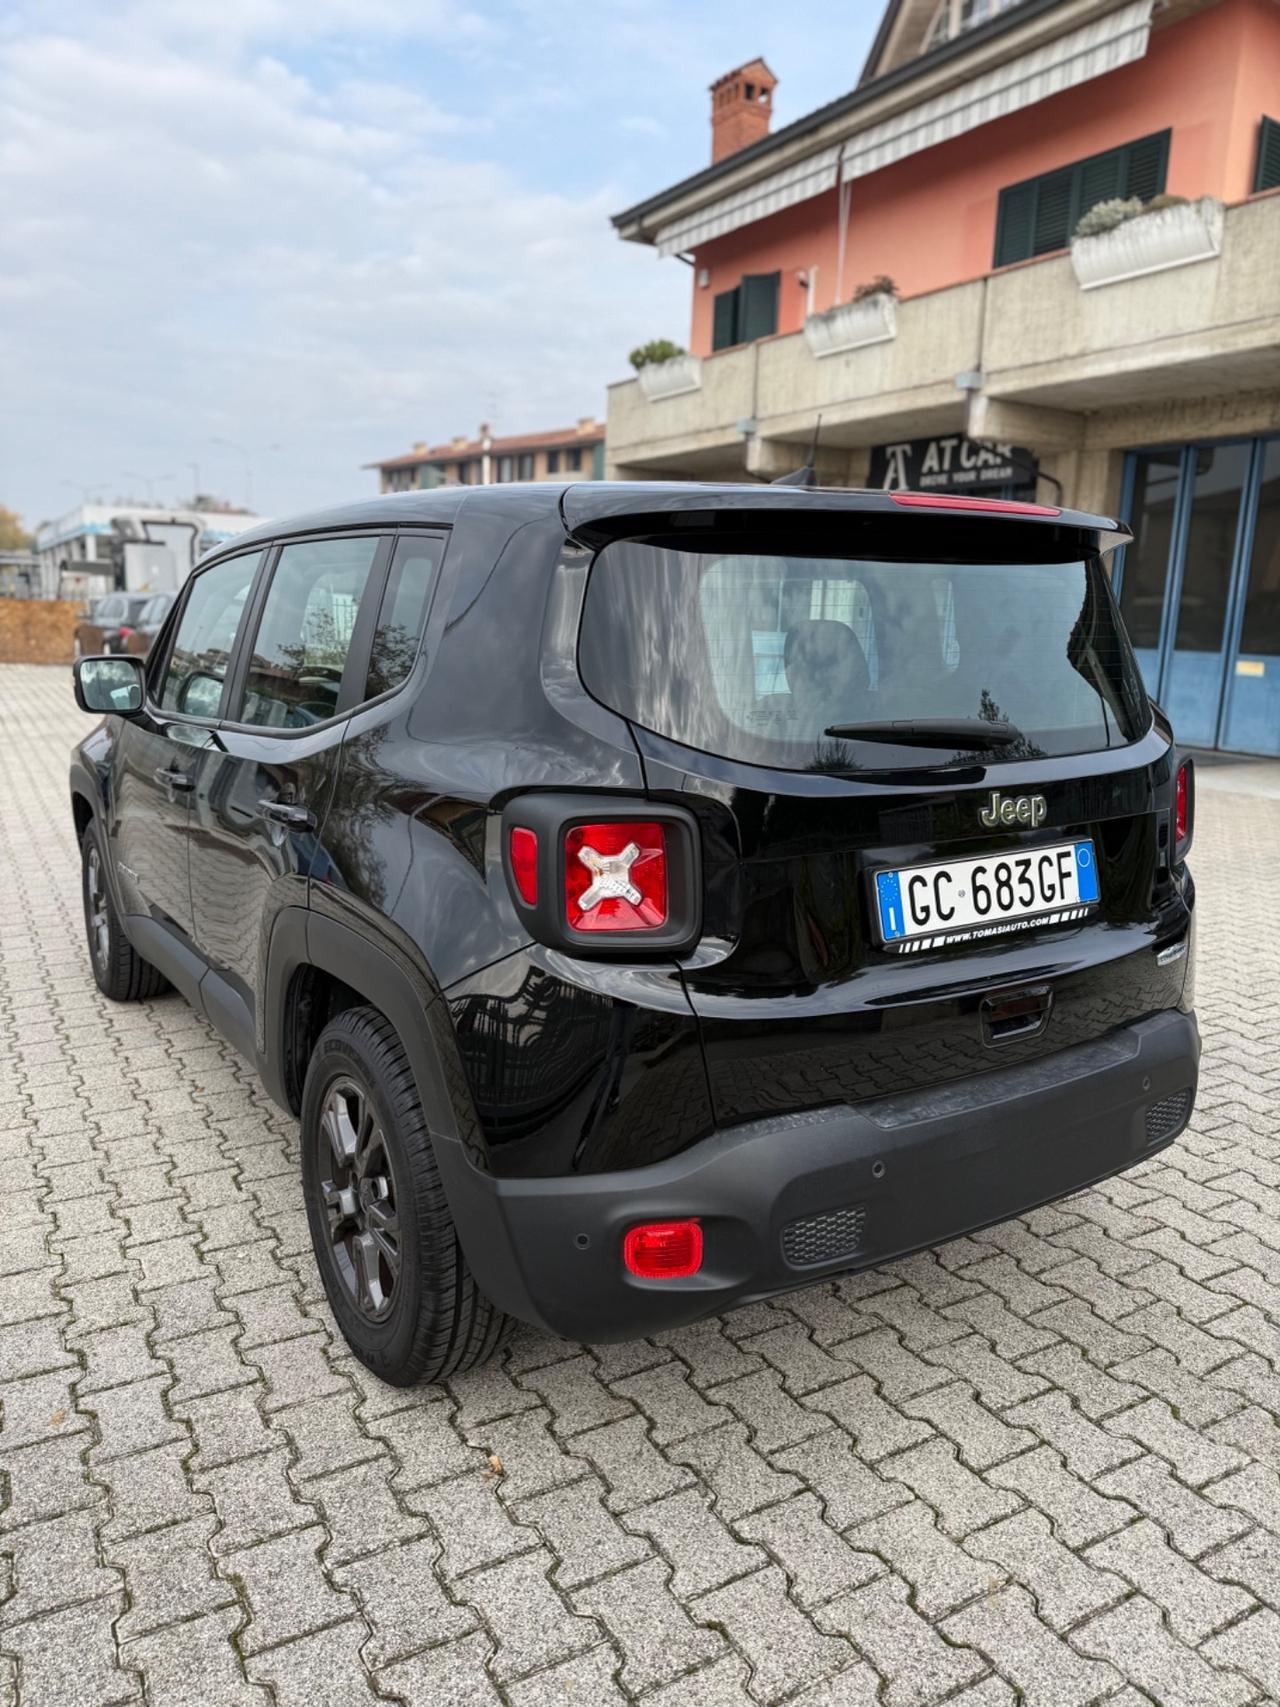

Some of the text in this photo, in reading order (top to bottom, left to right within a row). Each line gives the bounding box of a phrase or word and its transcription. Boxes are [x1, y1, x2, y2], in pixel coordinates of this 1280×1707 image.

[921, 439, 959, 474] AT
[952, 470, 977, 482] YOUR
[980, 792, 1047, 827] Jeep
[908, 851, 1072, 926] GC 683GF
